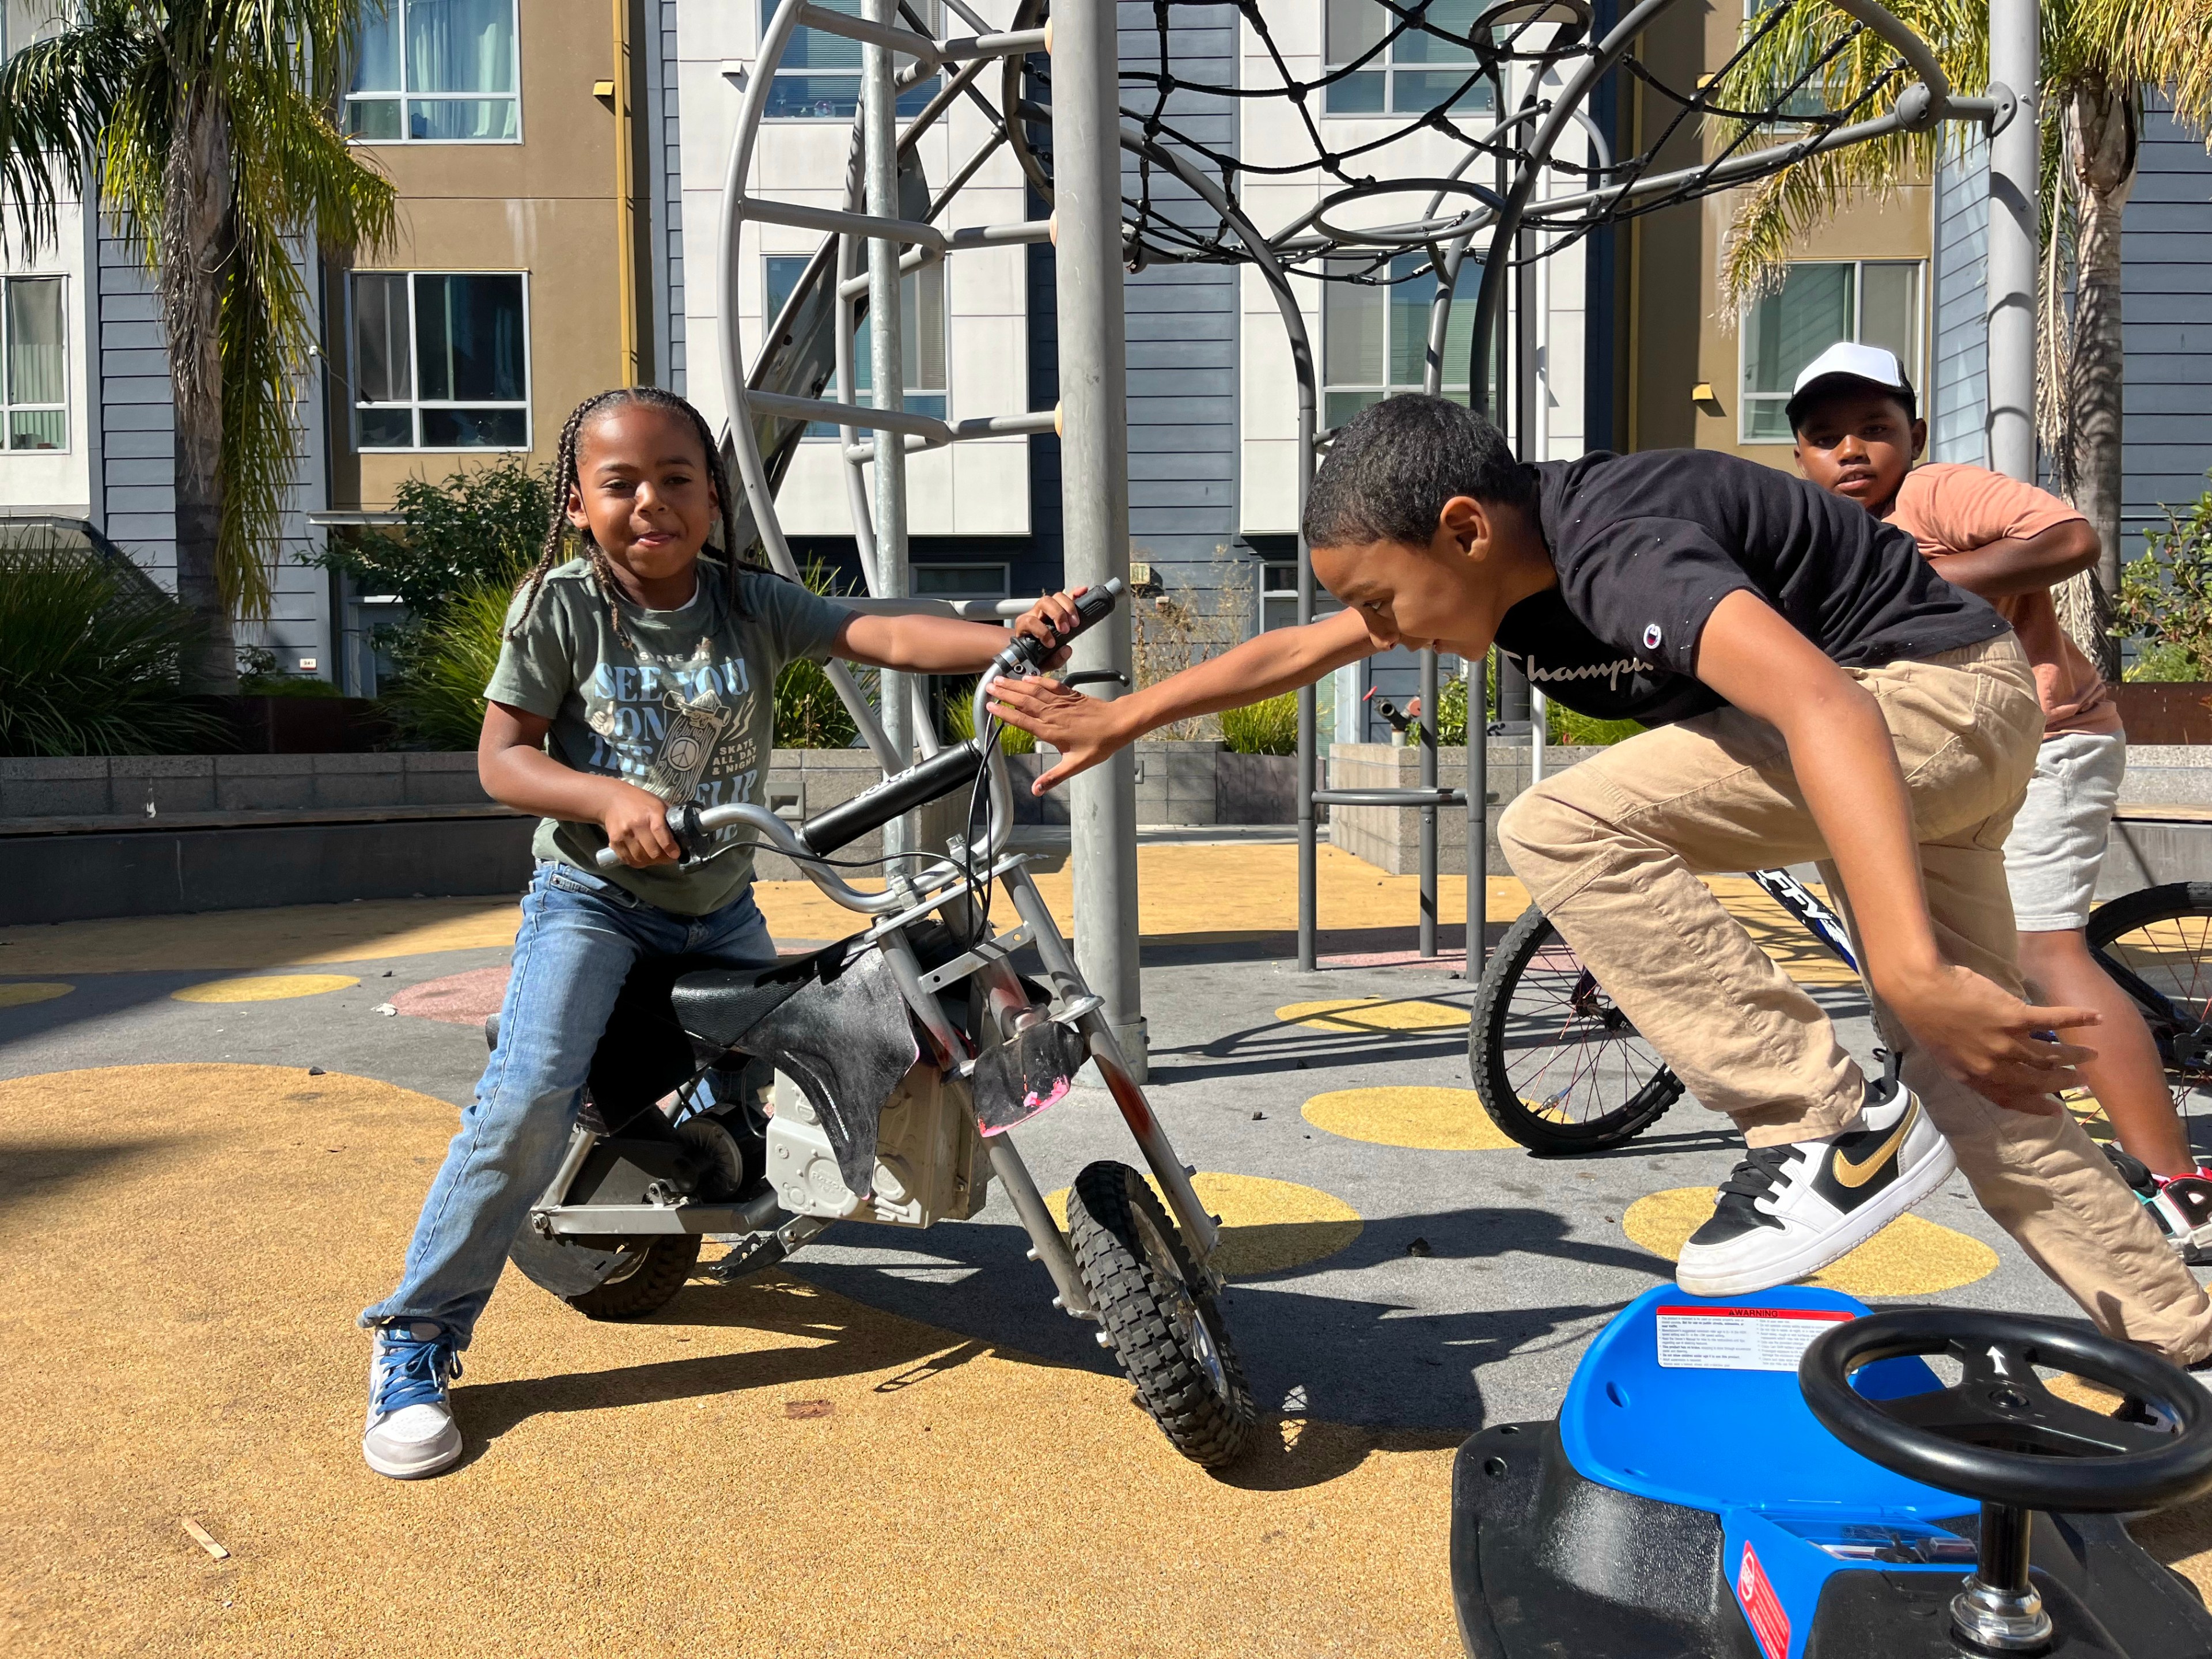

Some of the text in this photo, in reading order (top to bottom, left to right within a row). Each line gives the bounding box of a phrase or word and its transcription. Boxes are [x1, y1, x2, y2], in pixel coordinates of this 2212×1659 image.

[639, 652, 684, 662] SATE
[594, 658, 749, 702] SEE YOU
[614, 707, 666, 741] ON
[713, 745, 757, 766] ALL DAY
[719, 738, 753, 755] SKATE
[712, 755, 756, 775] & NIGHT
[1734, 1309, 1778, 1318] WARNING
